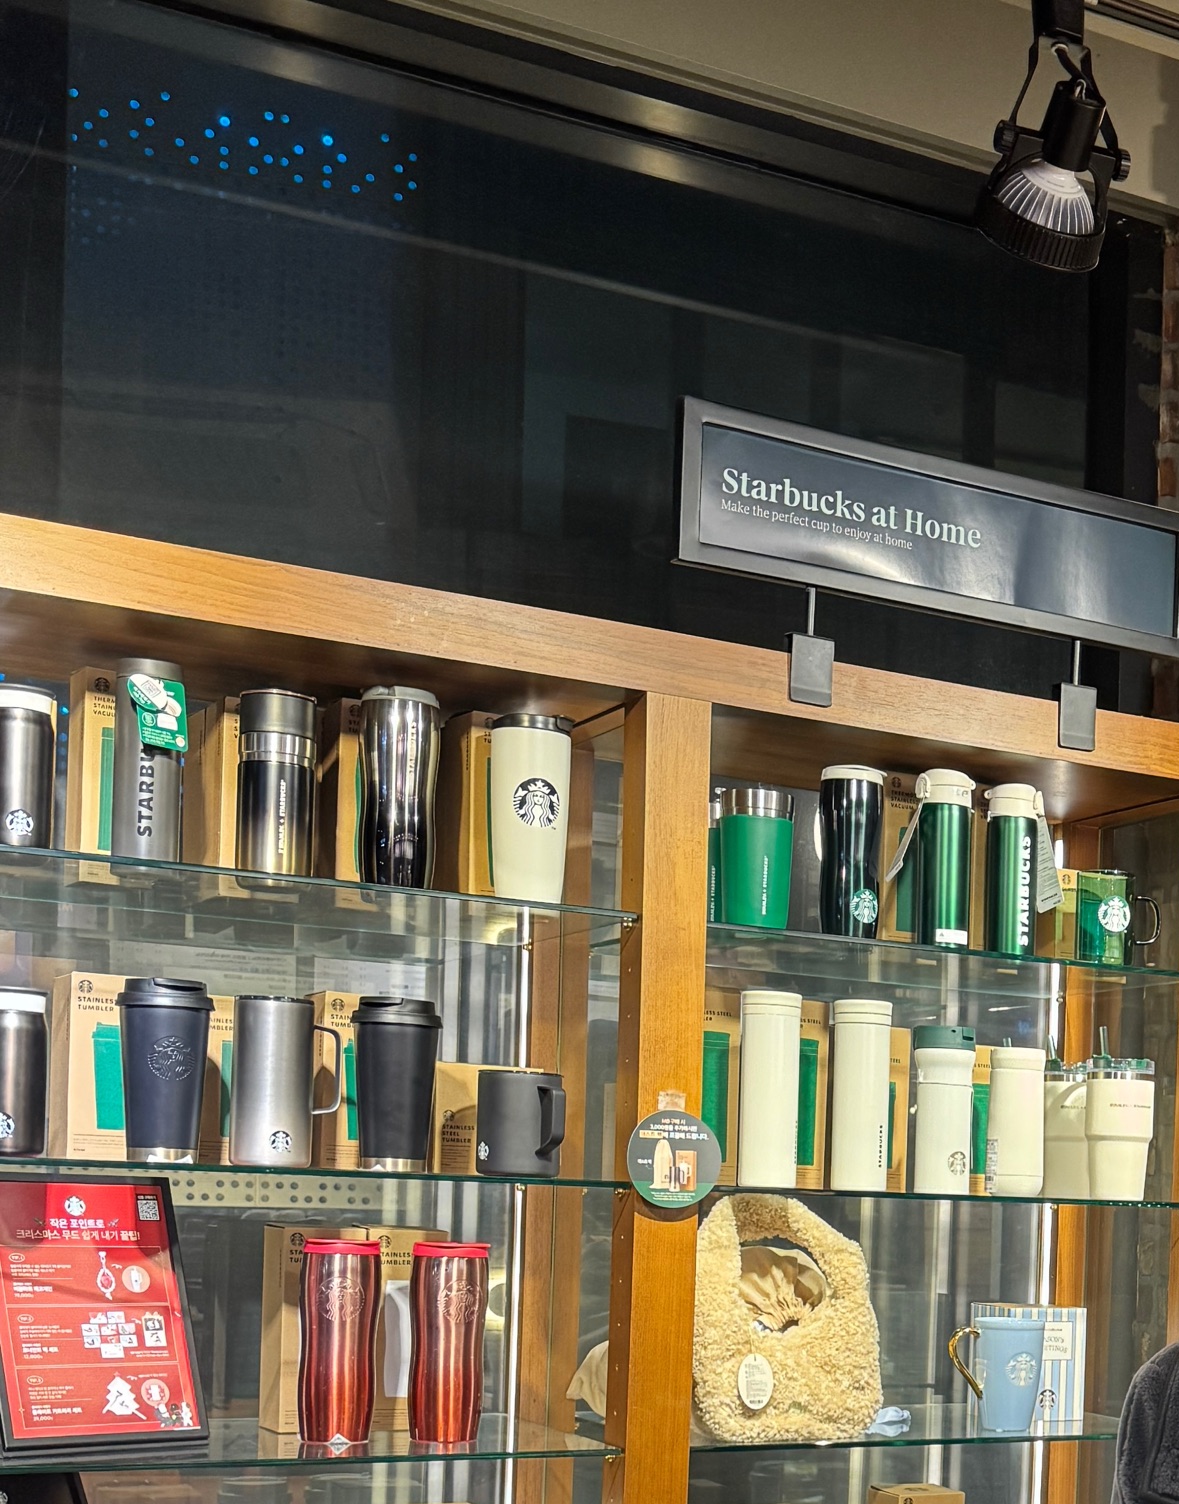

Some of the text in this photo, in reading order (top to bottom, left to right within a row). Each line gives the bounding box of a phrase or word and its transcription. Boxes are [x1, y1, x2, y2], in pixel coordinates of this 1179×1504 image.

[721, 467, 982, 548] Starbucks at Home
[720, 498, 913, 550] Make the perfect cup to enjoy at home
[1018, 836, 1032, 947] STARBUCKS
[77, 996, 117, 1005] STAINLES
[78, 1004, 115, 1012] TUMBLER
[49, 1218, 105, 1229] 작은 포인트로
[16, 1229, 60, 1240] 크리스마스
[62, 1230, 80, 1240] 무드
[101, 1229, 119, 1241] 내기
